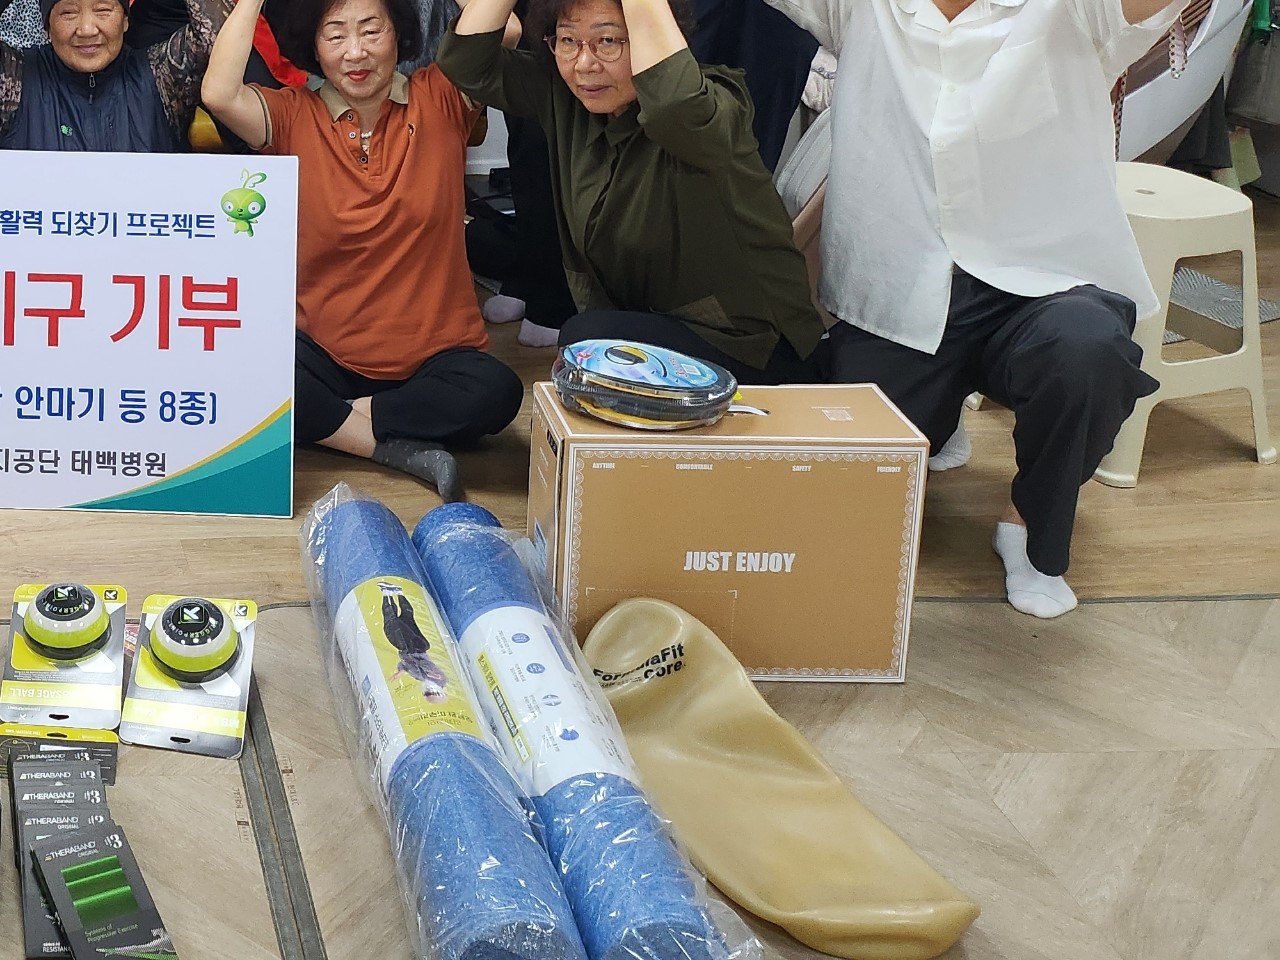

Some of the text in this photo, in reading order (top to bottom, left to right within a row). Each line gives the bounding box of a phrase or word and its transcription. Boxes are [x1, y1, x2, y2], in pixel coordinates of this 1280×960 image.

[0, 210, 43, 236] 활력
[51, 210, 118, 238] 되찾기
[126, 212, 216, 240] 프로젝트
[110, 273, 242, 352] 기부
[14, 385, 106, 423] 안마기
[118, 389, 147, 425] 등
[71, 448, 168, 478] 태백병원
[683, 551, 796, 573] JUST ENJOY
[643, 660, 683, 680] Core
[10, 687, 35, 697] BALL
[29, 792, 75, 800] THERABAND
[31, 816, 78, 825] THERABAND
[49, 841, 96, 860] THERABAND
[85, 926, 105, 937] Systems
[87, 924, 138, 943] Progressive Exercise
